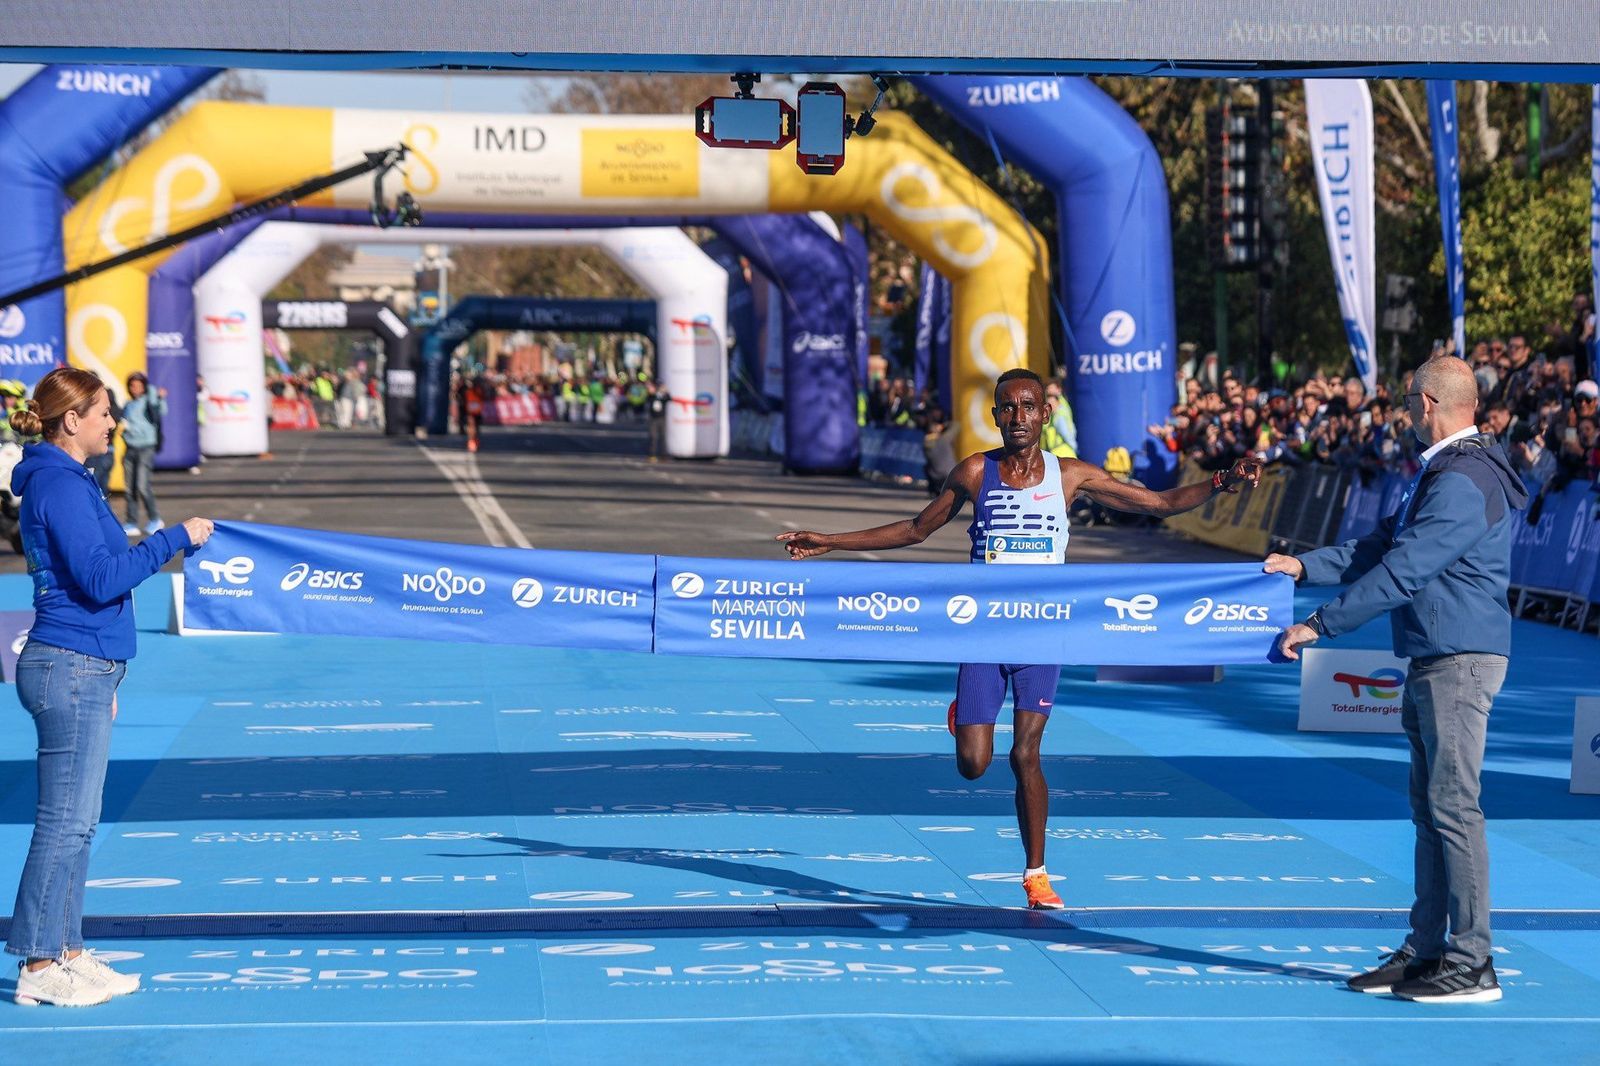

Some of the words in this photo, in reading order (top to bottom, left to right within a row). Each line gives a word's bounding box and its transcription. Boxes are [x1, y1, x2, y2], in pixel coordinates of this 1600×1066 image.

[1228, 19, 1412, 45] AYUNTAMIENTO
[1421, 24, 1452, 45] DE
[1460, 21, 1550, 46] SEVILLA
[56, 70, 151, 96] ZURICH
[966, 80, 1060, 106] ZURICH
[474, 126, 546, 151] IMD
[0, 343, 54, 365] RICH
[1078, 350, 1162, 375] ZURICH
[1011, 541, 1047, 550] ZURICH
[198, 586, 253, 598] TotalEnergies
[714, 579, 805, 596] ZURICH
[552, 586, 637, 608] ZURICH
[402, 603, 449, 613] AYUNTAMIENTO
[460, 606, 484, 615] SEVILLA
[712, 598, 805, 617] MARATÓN
[987, 601, 1071, 620] ZURICH
[710, 619, 805, 640] SEVILLA
[837, 623, 884, 632] AYUNTAMIENTO
[1103, 623, 1158, 633] TotalEnergies
[219, 874, 497, 885] ZURICH
[1103, 874, 1377, 884] ZURICH
[188, 947, 506, 958] ZURICH
[698, 940, 1013, 952] ZURICH
